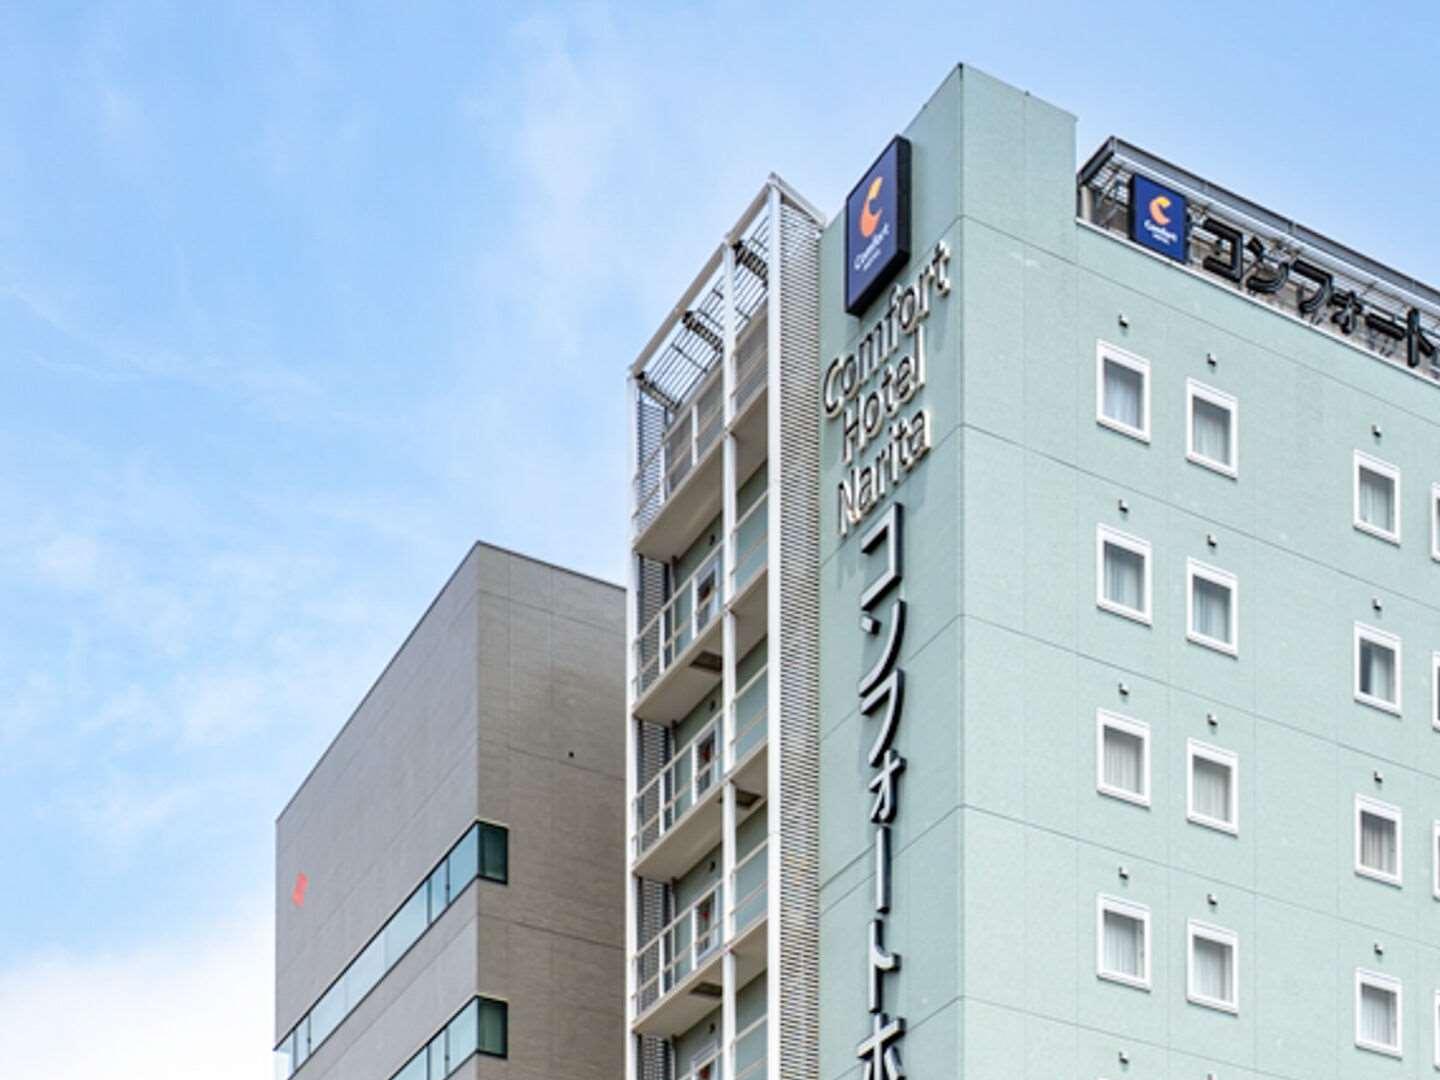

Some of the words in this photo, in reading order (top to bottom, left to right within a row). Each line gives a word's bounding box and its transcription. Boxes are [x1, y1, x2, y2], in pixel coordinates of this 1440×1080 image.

[823, 239, 951, 419] Comfort
[842, 323, 926, 466] Hotel
[838, 408, 932, 536] Narita
